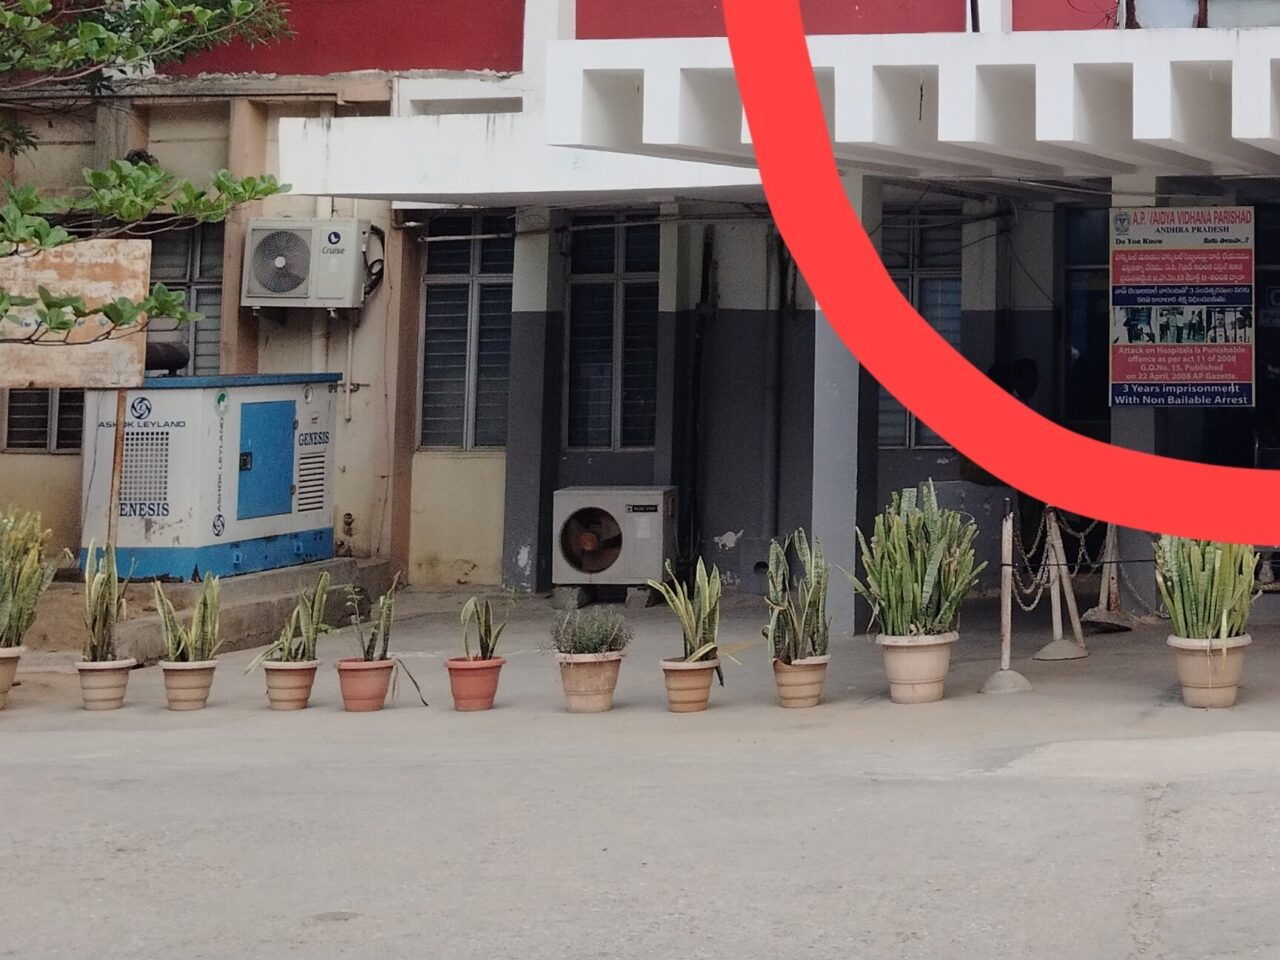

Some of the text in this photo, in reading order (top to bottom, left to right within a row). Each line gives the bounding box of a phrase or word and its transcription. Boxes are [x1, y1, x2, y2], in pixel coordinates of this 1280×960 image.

[1132, 211, 1146, 225] A.P.
[1177, 210, 1212, 225] VIDHANA
[1213, 210, 1252, 224] PARISHAD
[1191, 225, 1230, 233] PRADESH
[322, 246, 345, 255] Cruise
[1157, 347, 1193, 355] Hospitals
[1128, 355, 1156, 363] offence
[1167, 356, 1181, 364] per
[1183, 355, 1195, 363] act
[1197, 355, 1205, 363] 11
[1207, 355, 1216, 363] of
[1217, 355, 1237, 363] 2008
[1184, 363, 1224, 371] Published
[1122, 384, 1240, 395] 3 Years imprisonment
[1115, 396, 1248, 404] With Non Bailable Arrest
[299, 431, 330, 446] GENESIS
[119, 503, 169, 517] ENESIS
